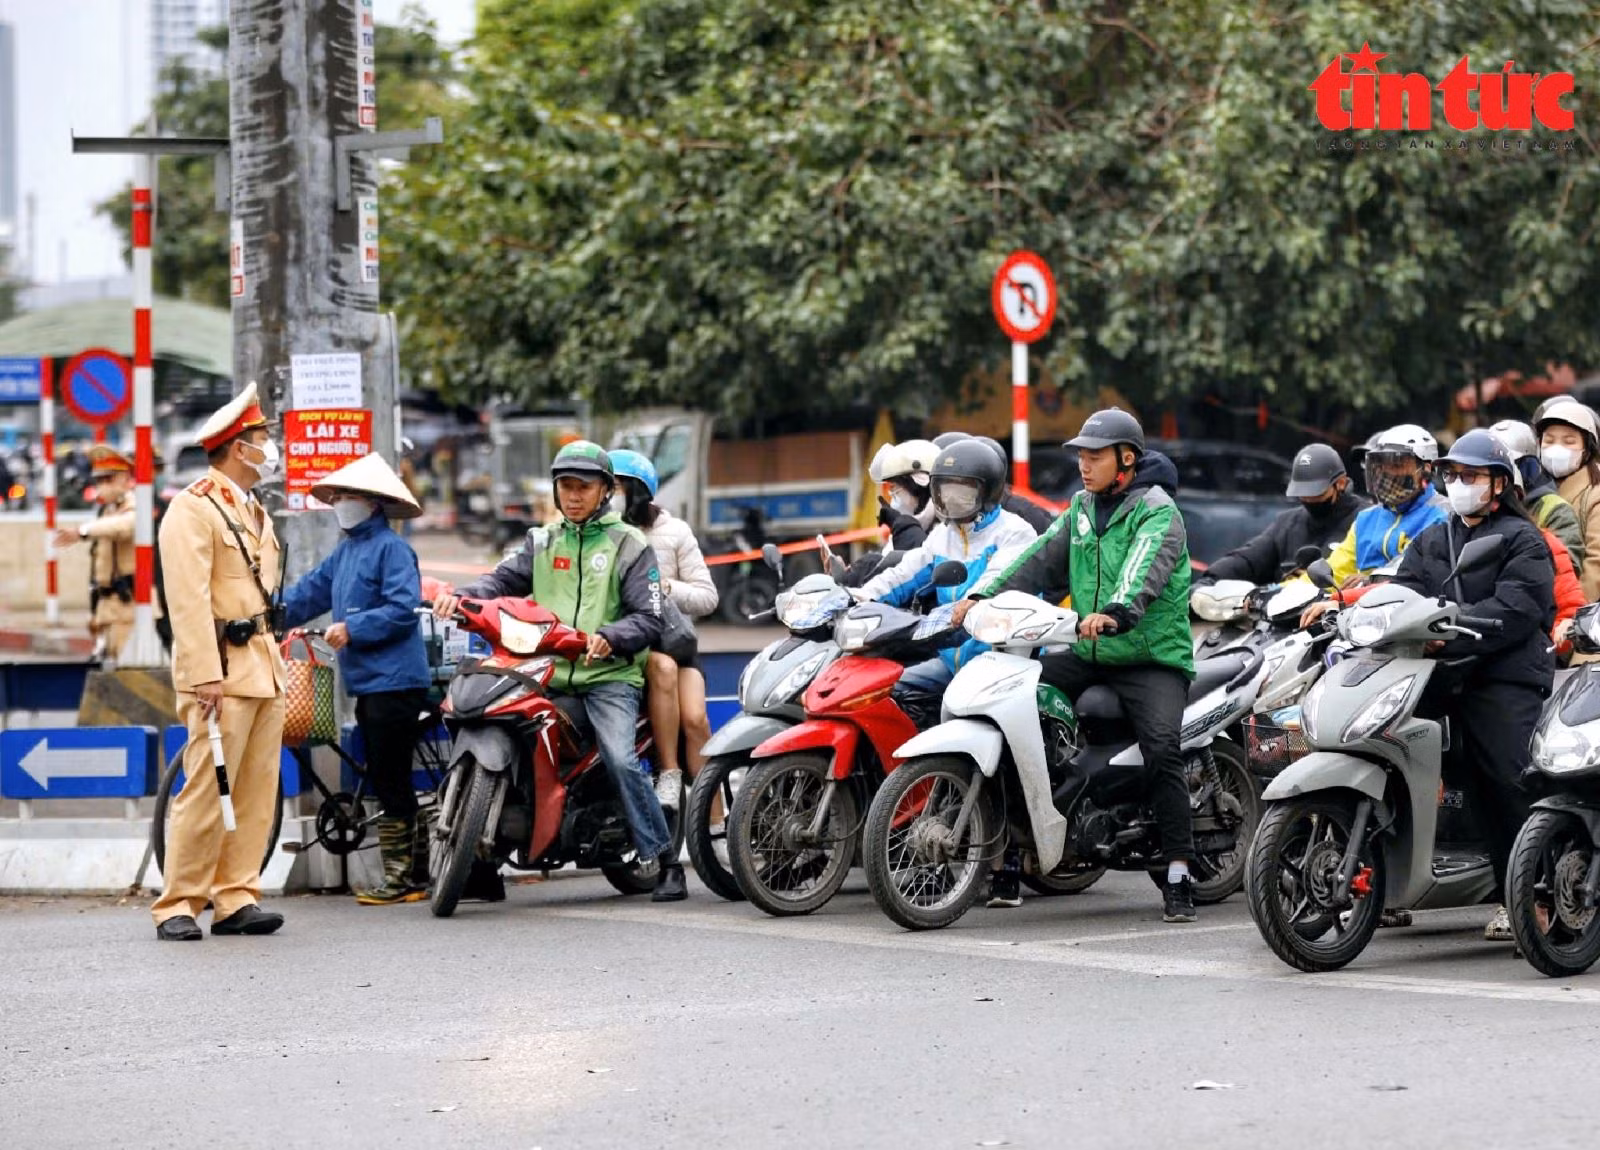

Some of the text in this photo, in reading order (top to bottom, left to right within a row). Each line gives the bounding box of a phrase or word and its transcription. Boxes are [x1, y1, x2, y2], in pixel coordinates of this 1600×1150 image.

[306, 422, 360, 439] LÁI XE
[289, 441, 315, 456] CHO
[648, 582, 662, 619] gojek
